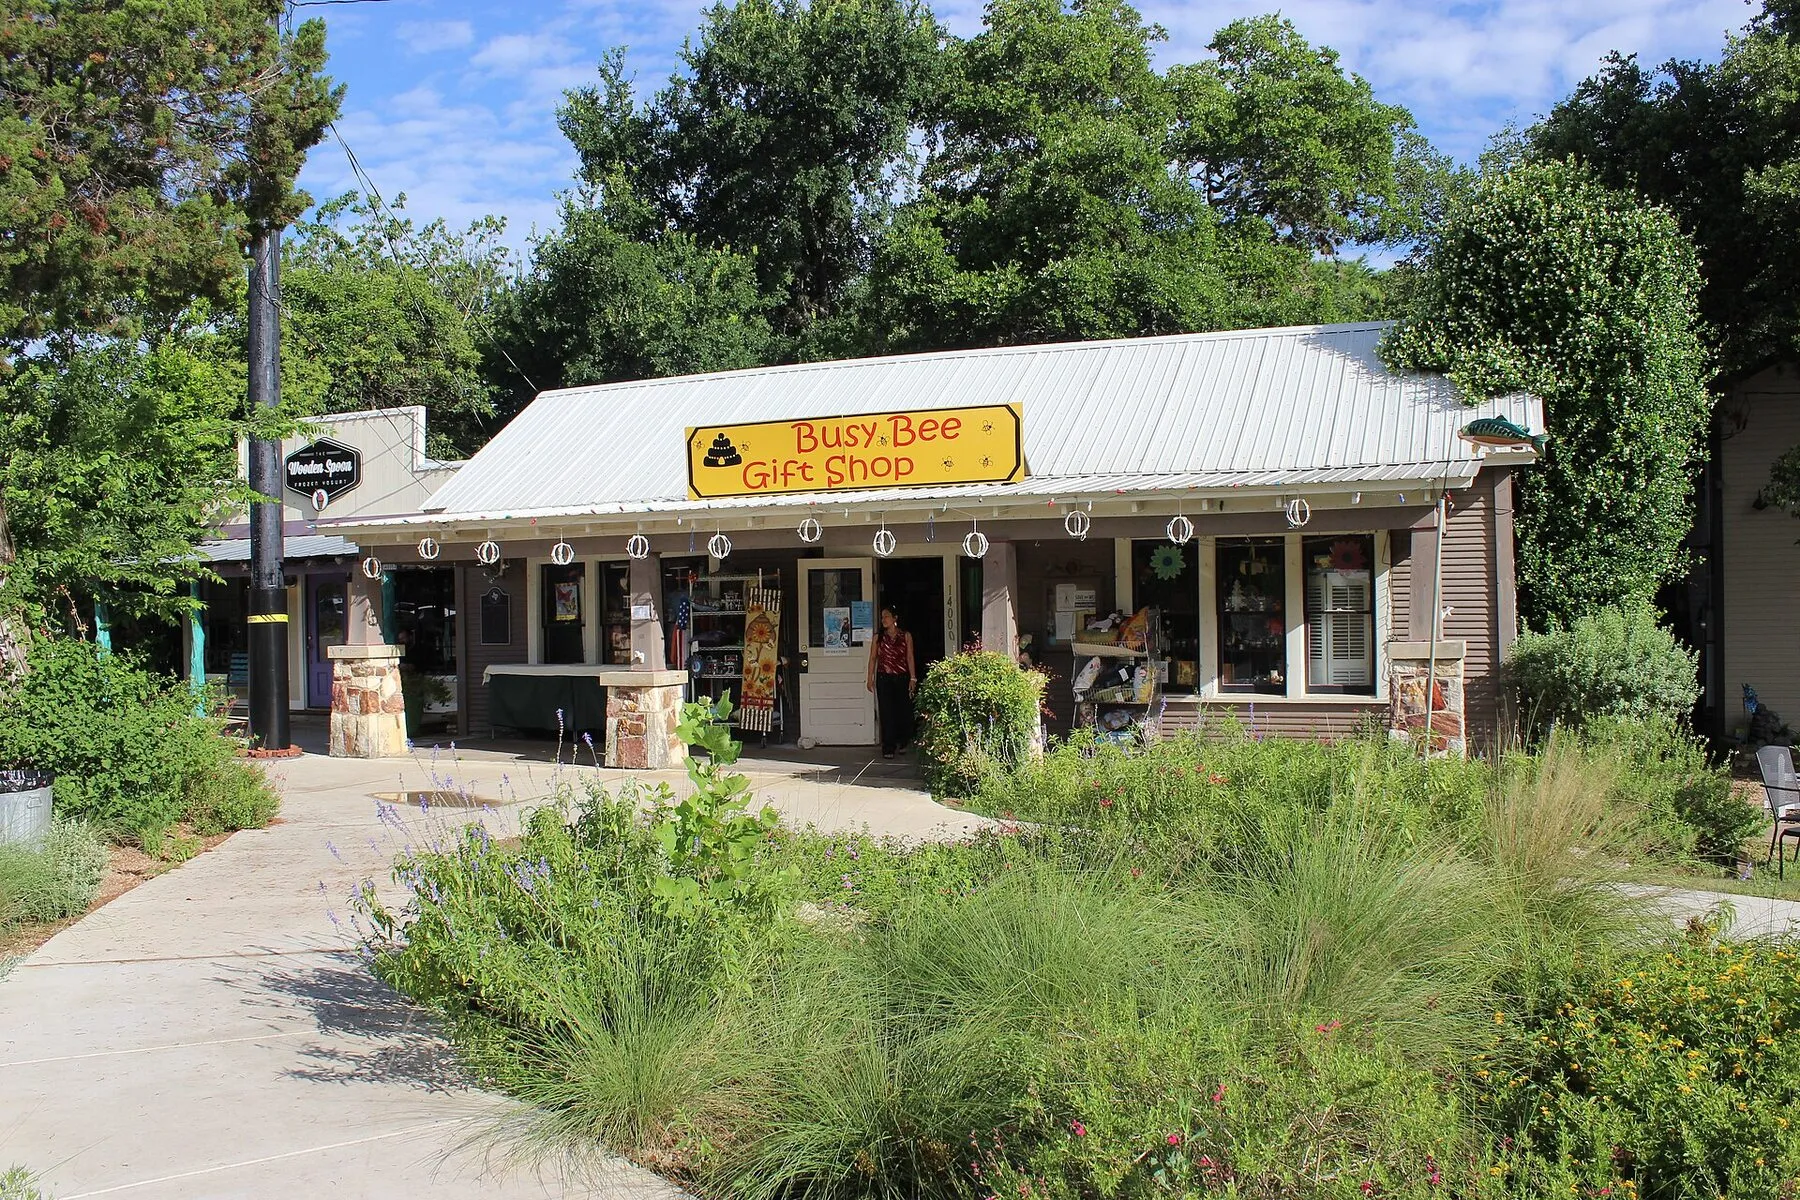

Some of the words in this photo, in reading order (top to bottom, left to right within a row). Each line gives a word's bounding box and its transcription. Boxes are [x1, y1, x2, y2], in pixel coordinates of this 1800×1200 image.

[790, 422, 877, 455] Busy
[886, 415, 962, 447] Bee
[288, 460, 324, 475] Wooden
[324, 459, 353, 478] Spoon
[742, 459, 814, 490] Gift
[825, 454, 914, 488] Shop
[947, 584, 955, 641] 14000
